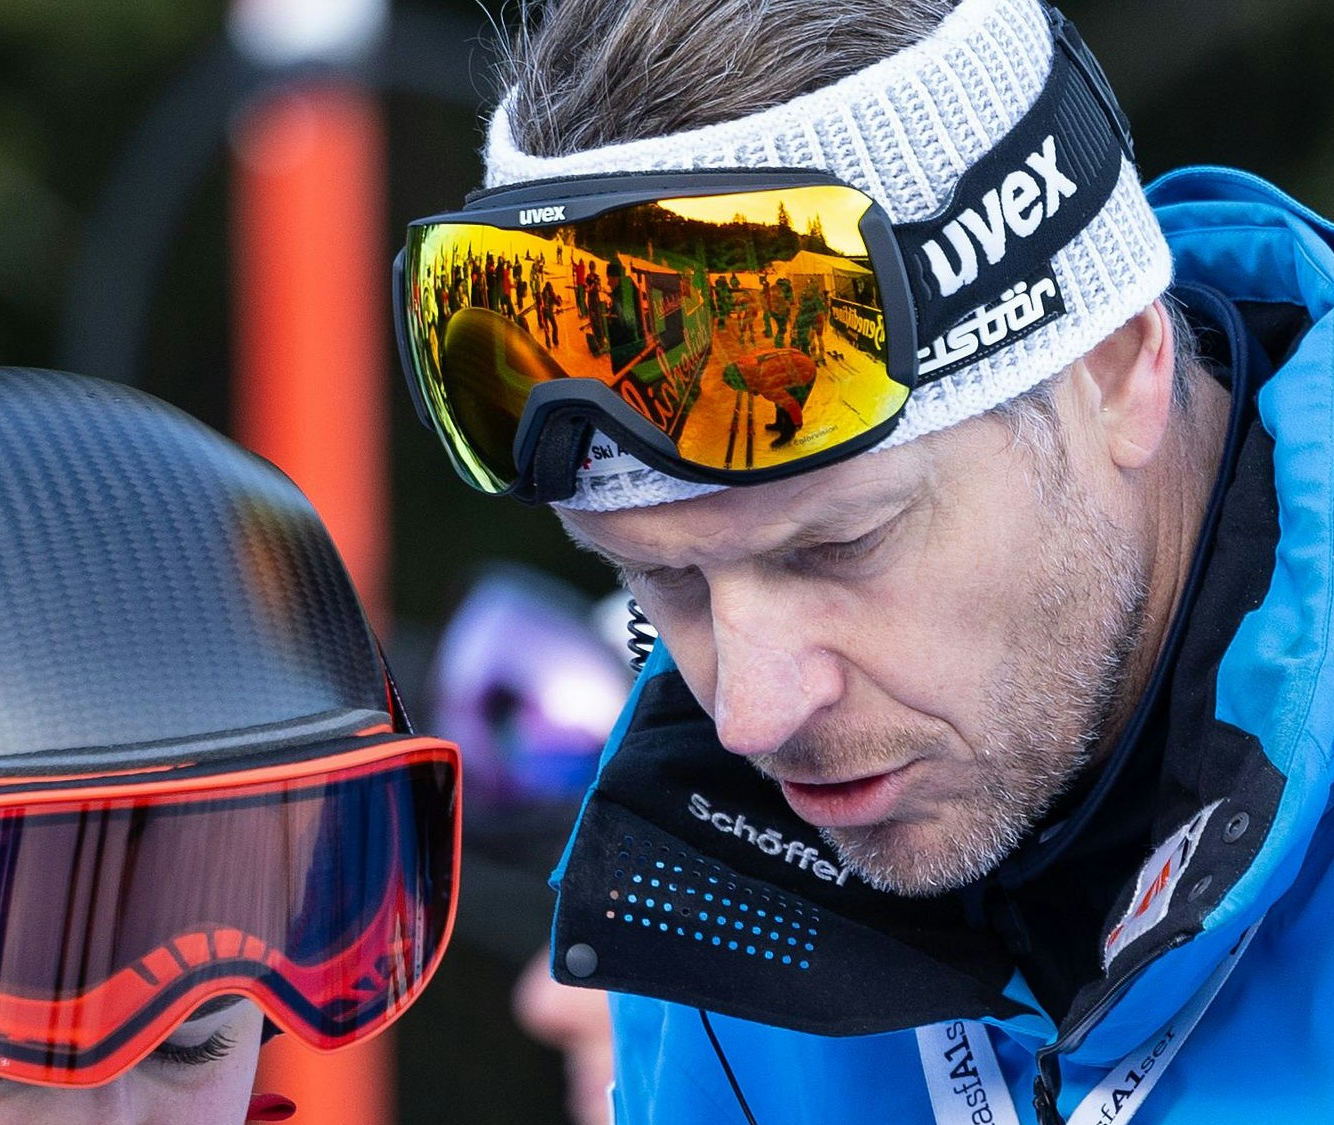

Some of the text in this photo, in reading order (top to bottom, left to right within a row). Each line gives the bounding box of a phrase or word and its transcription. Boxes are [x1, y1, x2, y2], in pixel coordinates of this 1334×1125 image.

[519, 205, 566, 226] uvex
[921, 135, 1077, 298] uvex
[591, 445, 614, 460] Ski
